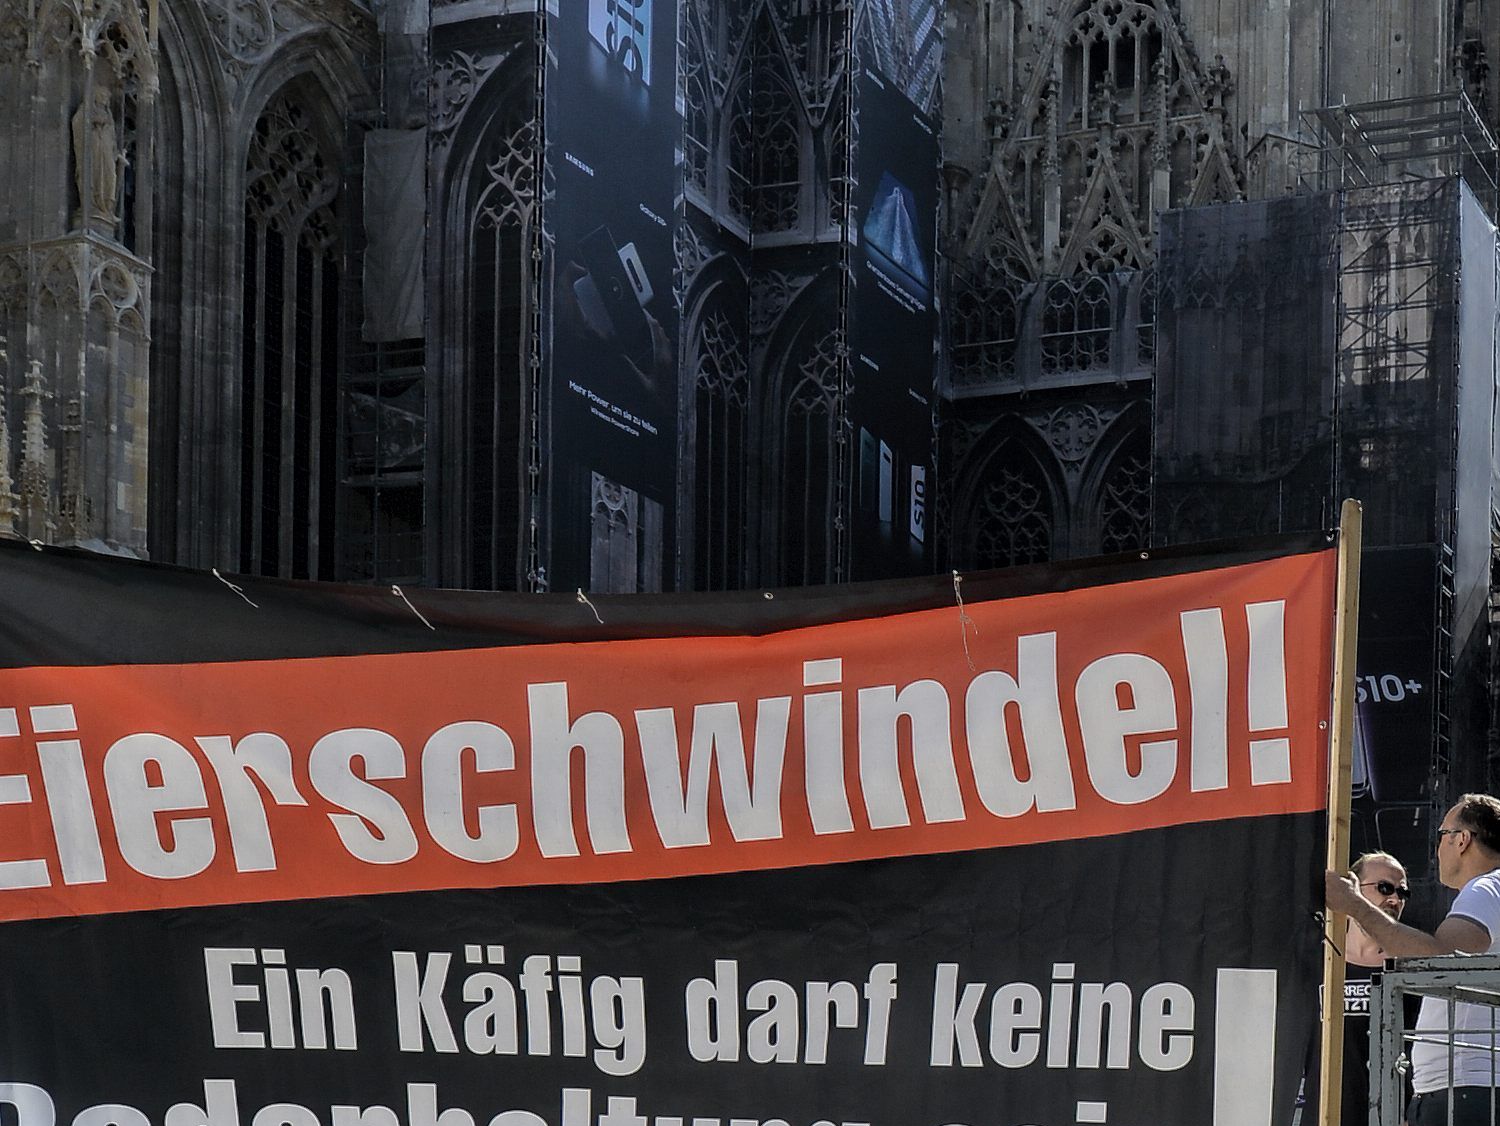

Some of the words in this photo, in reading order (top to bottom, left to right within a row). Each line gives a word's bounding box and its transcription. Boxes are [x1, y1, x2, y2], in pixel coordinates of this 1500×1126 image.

[913, 480, 925, 529] S10
[204, 947, 358, 1052] Ein
[393, 944, 646, 1077] Käfig
[686, 959, 898, 1067] darf
[931, 962, 1195, 1071] keine
[1344, 999, 1367, 1011] TZT
